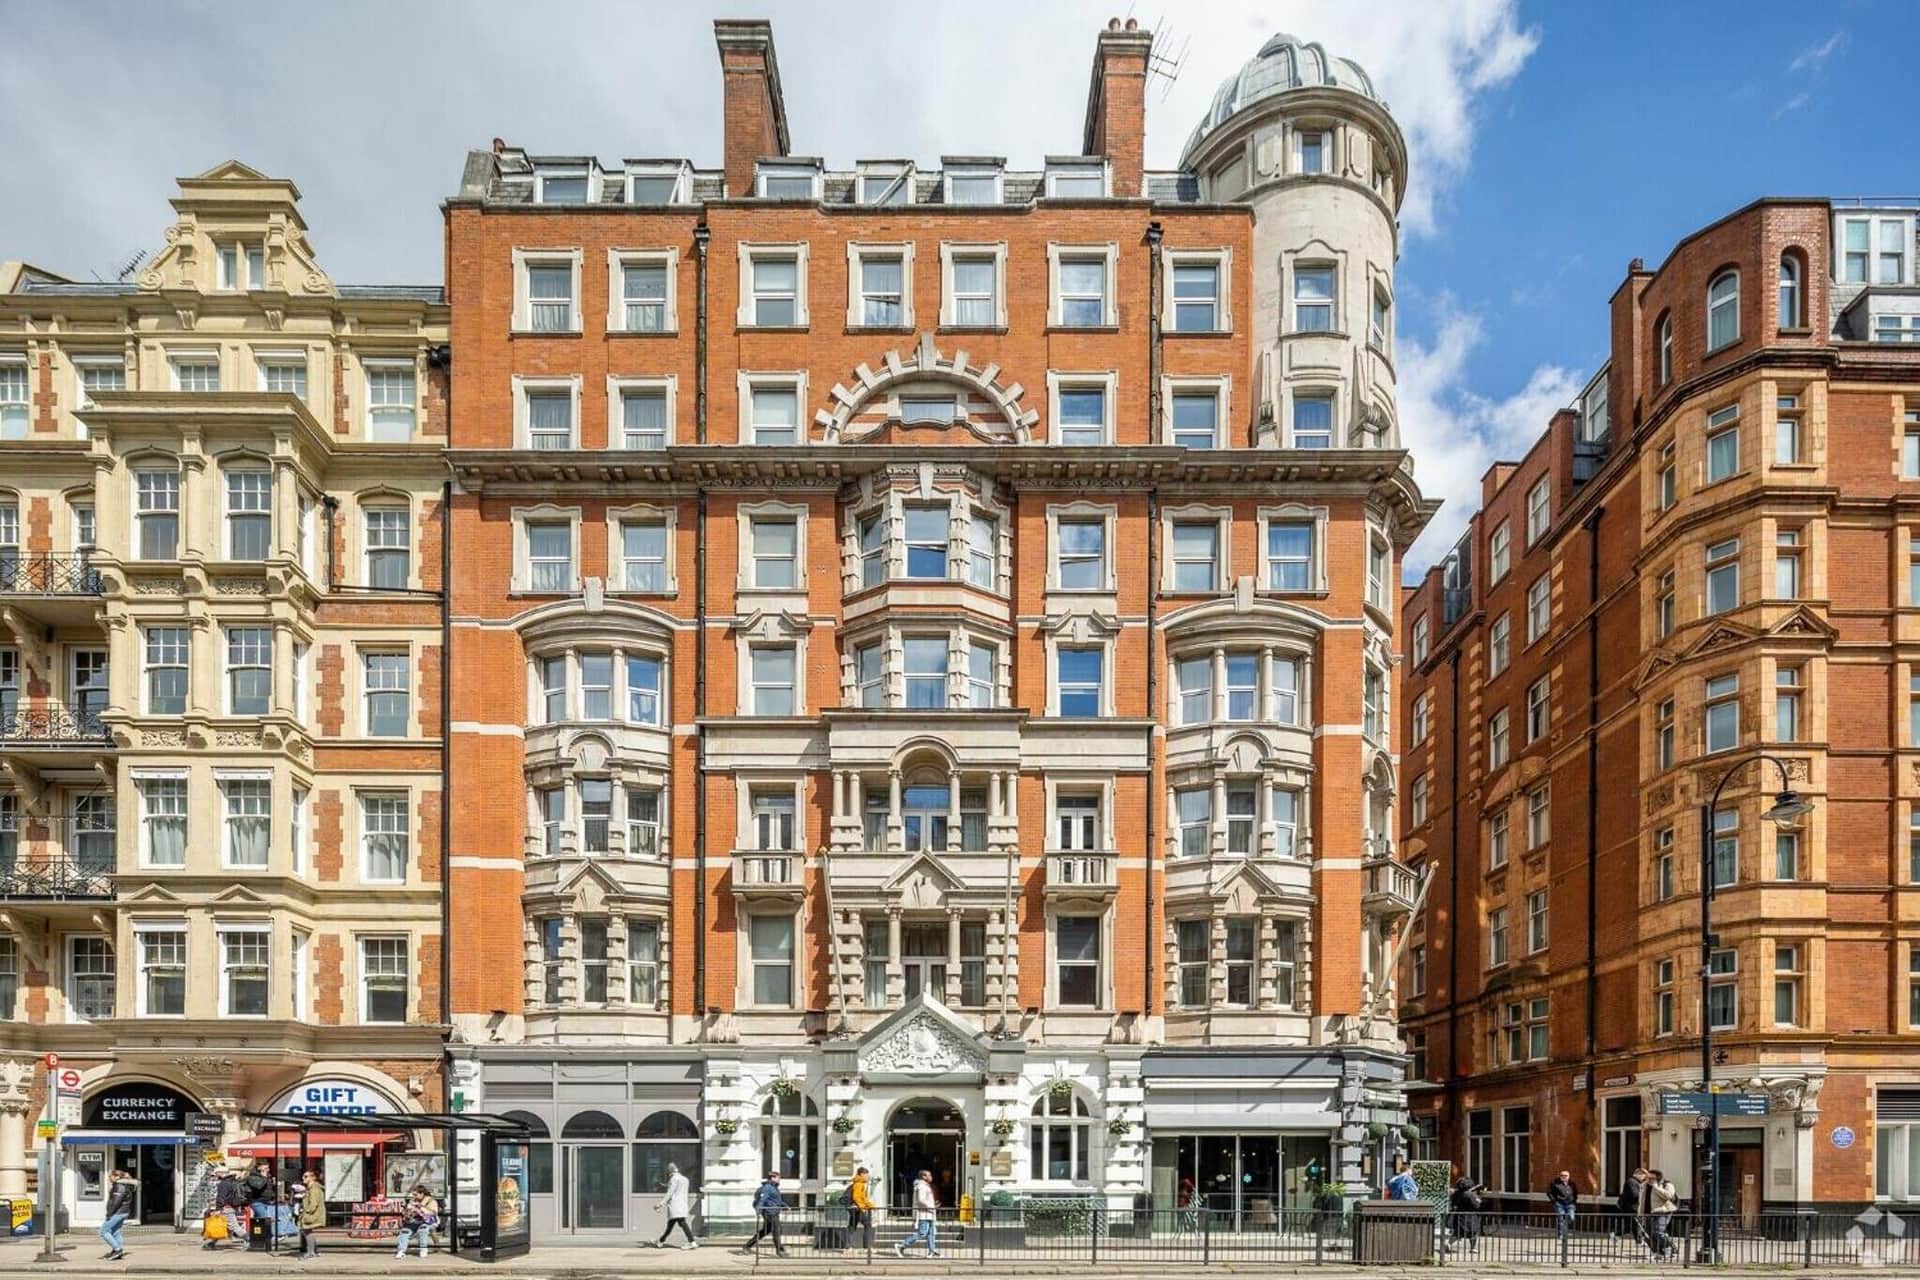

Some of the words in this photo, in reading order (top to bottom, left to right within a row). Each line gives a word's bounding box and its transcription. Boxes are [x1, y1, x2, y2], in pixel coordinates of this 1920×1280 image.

[306, 1087, 358, 1102] GIFT
[103, 1097, 176, 1107] CURRENCY
[103, 1110, 177, 1120] EXCHANGE
[13, 1203, 30, 1212] ATM
